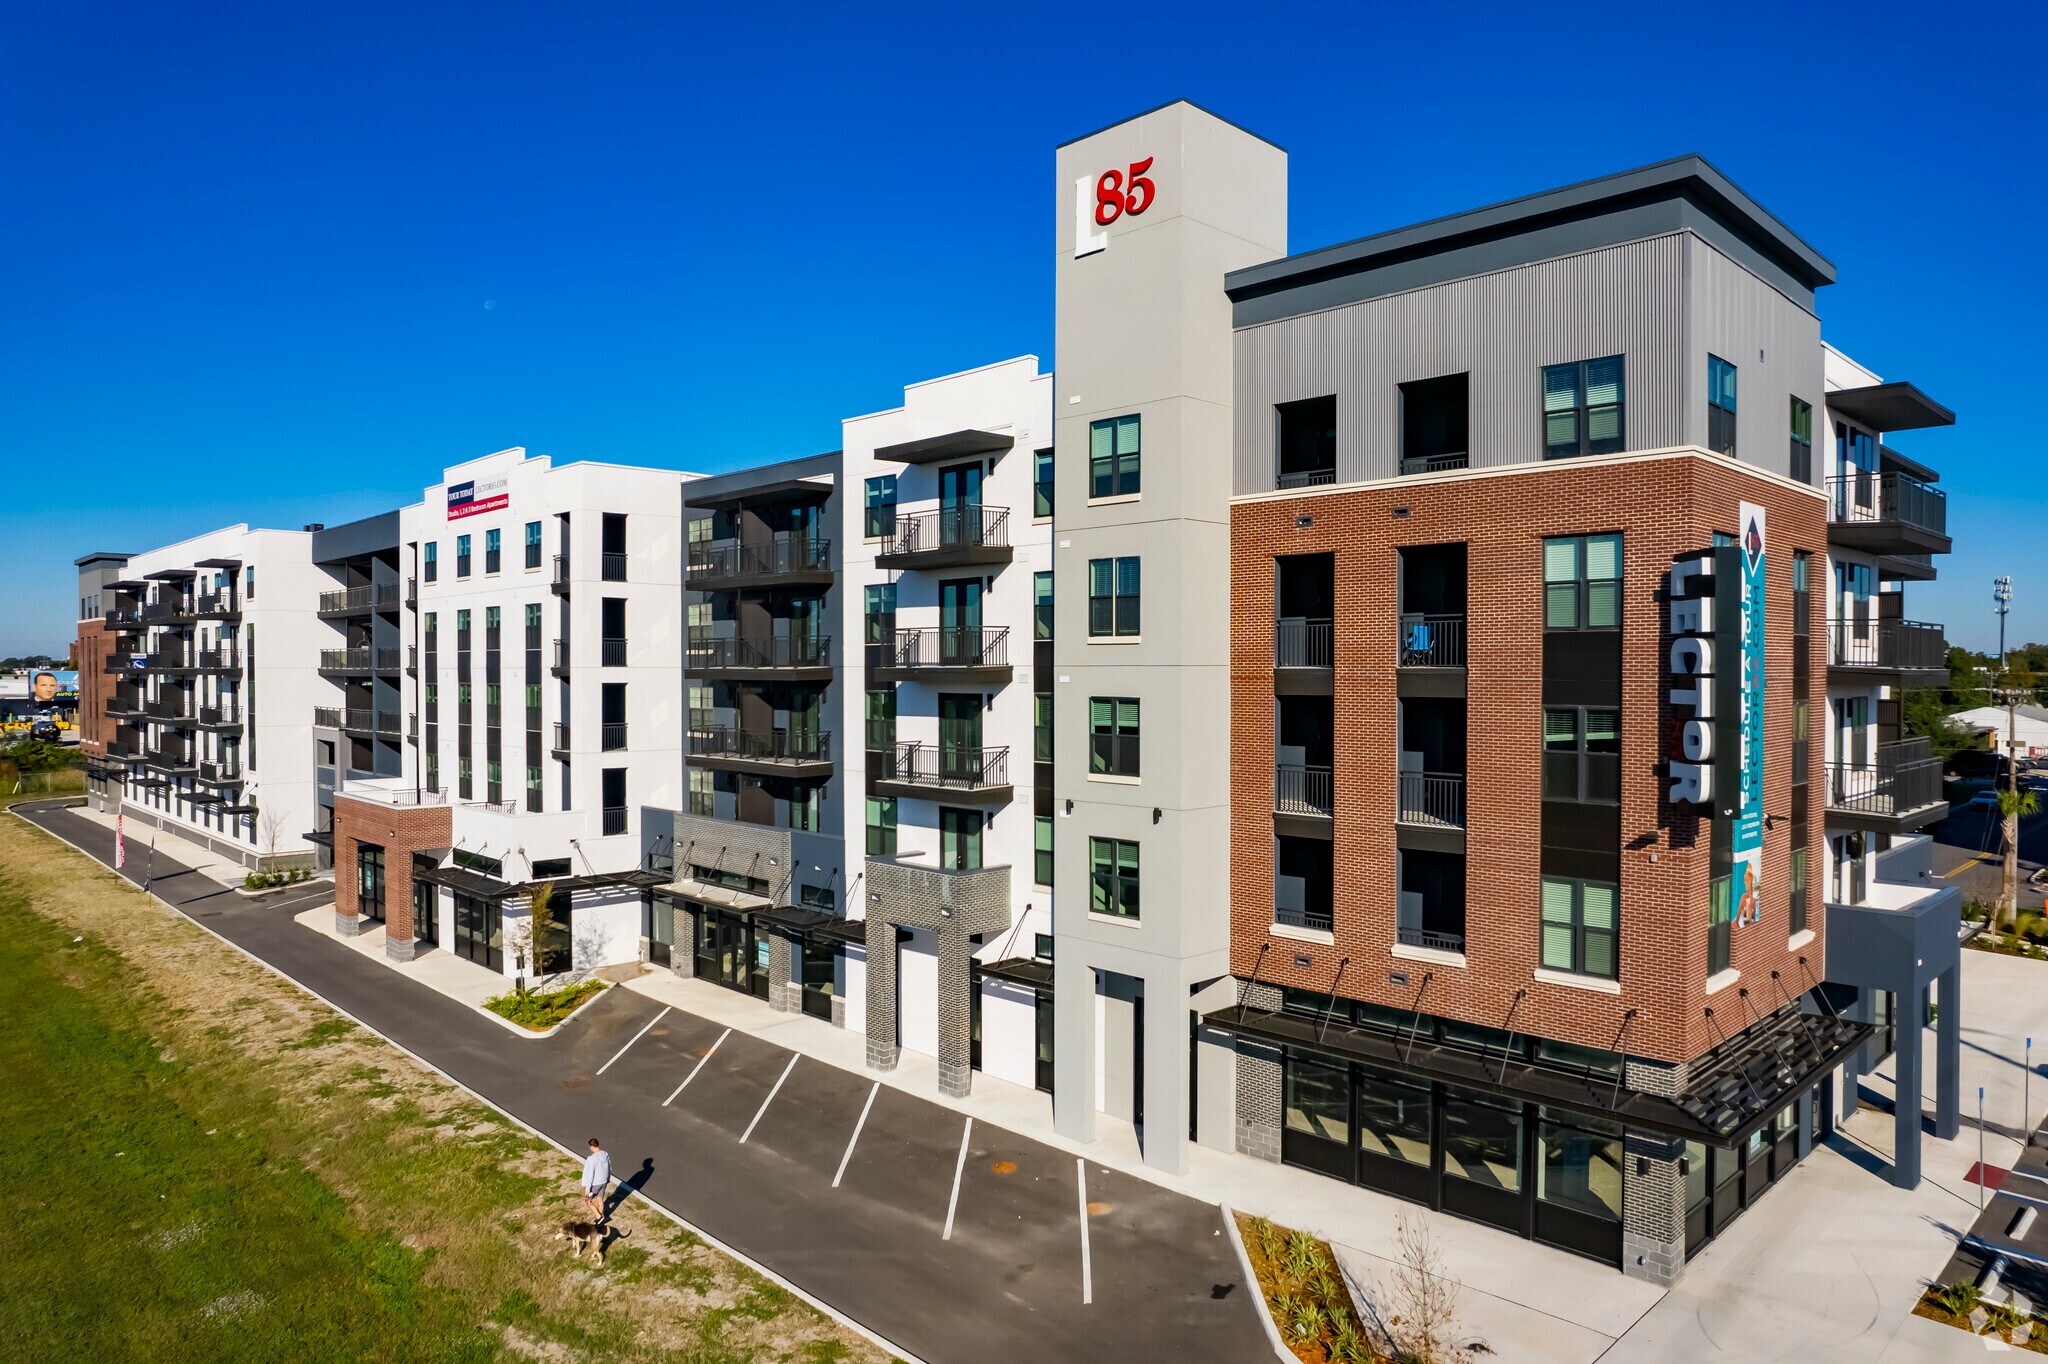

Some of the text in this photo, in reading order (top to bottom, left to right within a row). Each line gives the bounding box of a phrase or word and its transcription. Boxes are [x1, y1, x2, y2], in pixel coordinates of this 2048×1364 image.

[1744, 584, 1752, 648] TOUR
[1670, 556, 1712, 804] LECTOR
[1743, 680, 1752, 804] SCHEDULE
